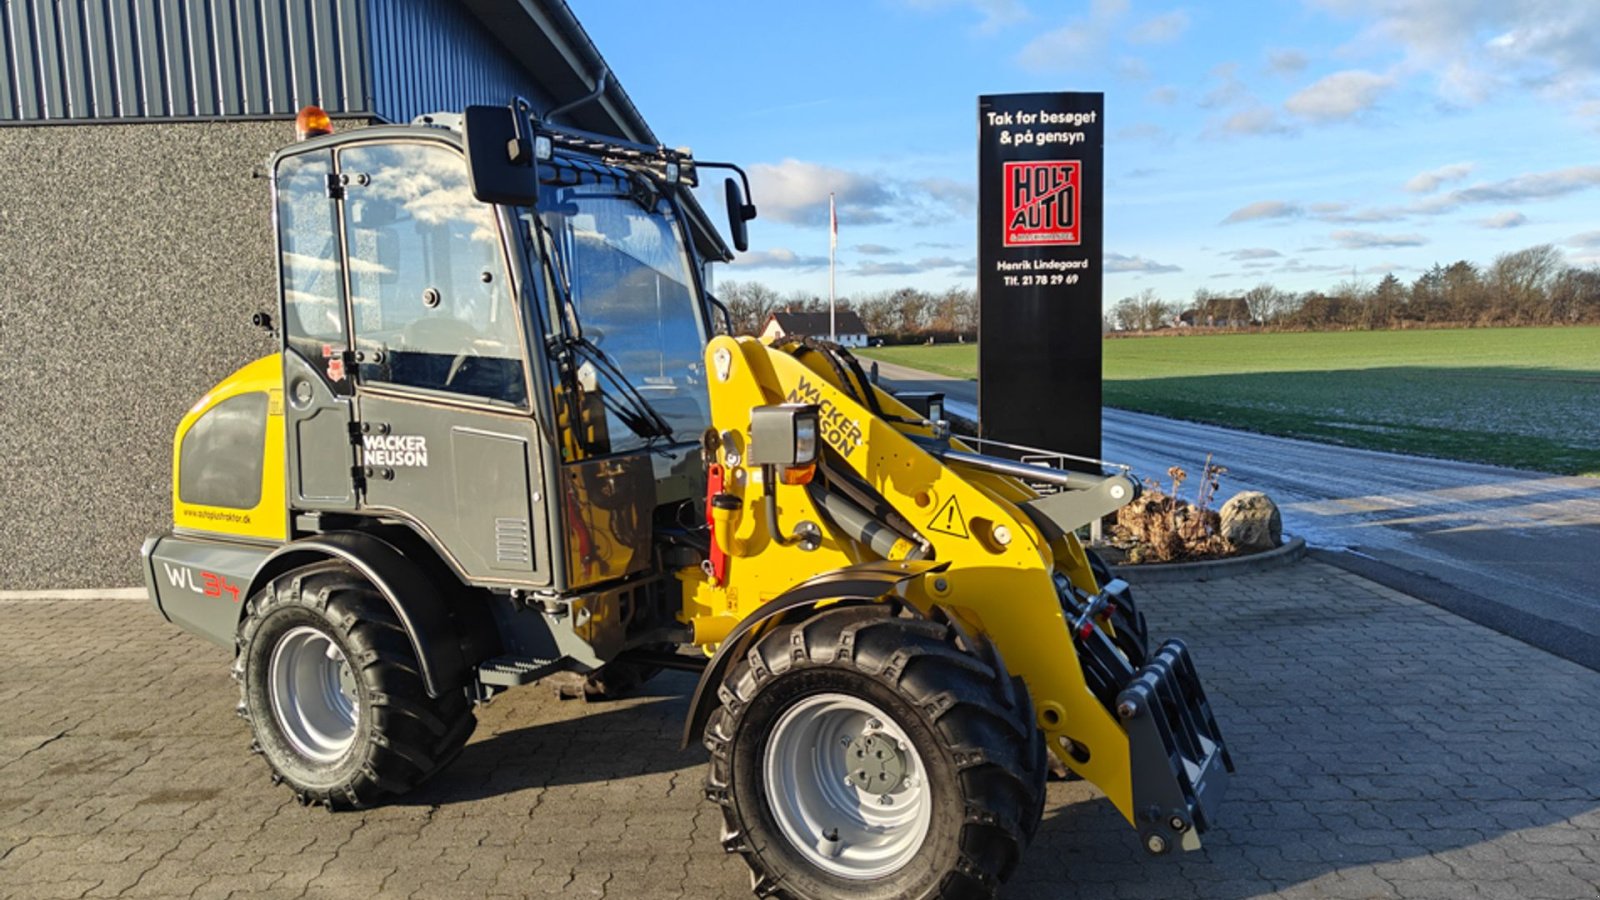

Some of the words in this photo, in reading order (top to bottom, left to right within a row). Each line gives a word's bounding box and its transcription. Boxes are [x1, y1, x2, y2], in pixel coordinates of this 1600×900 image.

[987, 111, 1013, 126] Tak
[1015, 110, 1037, 124] for
[1040, 110, 1096, 126] besøget
[1000, 130, 1012, 144] &
[1014, 129, 1034, 146] på
[1036, 131, 1085, 146] gensyn
[1013, 166, 1074, 210] HOLT
[1010, 185, 1075, 230] AUTO
[997, 260, 1032, 271] Henrik
[1034, 259, 1089, 272] Lindegaard
[1022, 275, 1033, 286] 21
[1035, 274, 1048, 285] 78
[1050, 274, 1064, 285] 29
[1066, 273, 1079, 285] 69
[363, 435, 427, 451] WACKER
[364, 450, 428, 467] NEUSON
